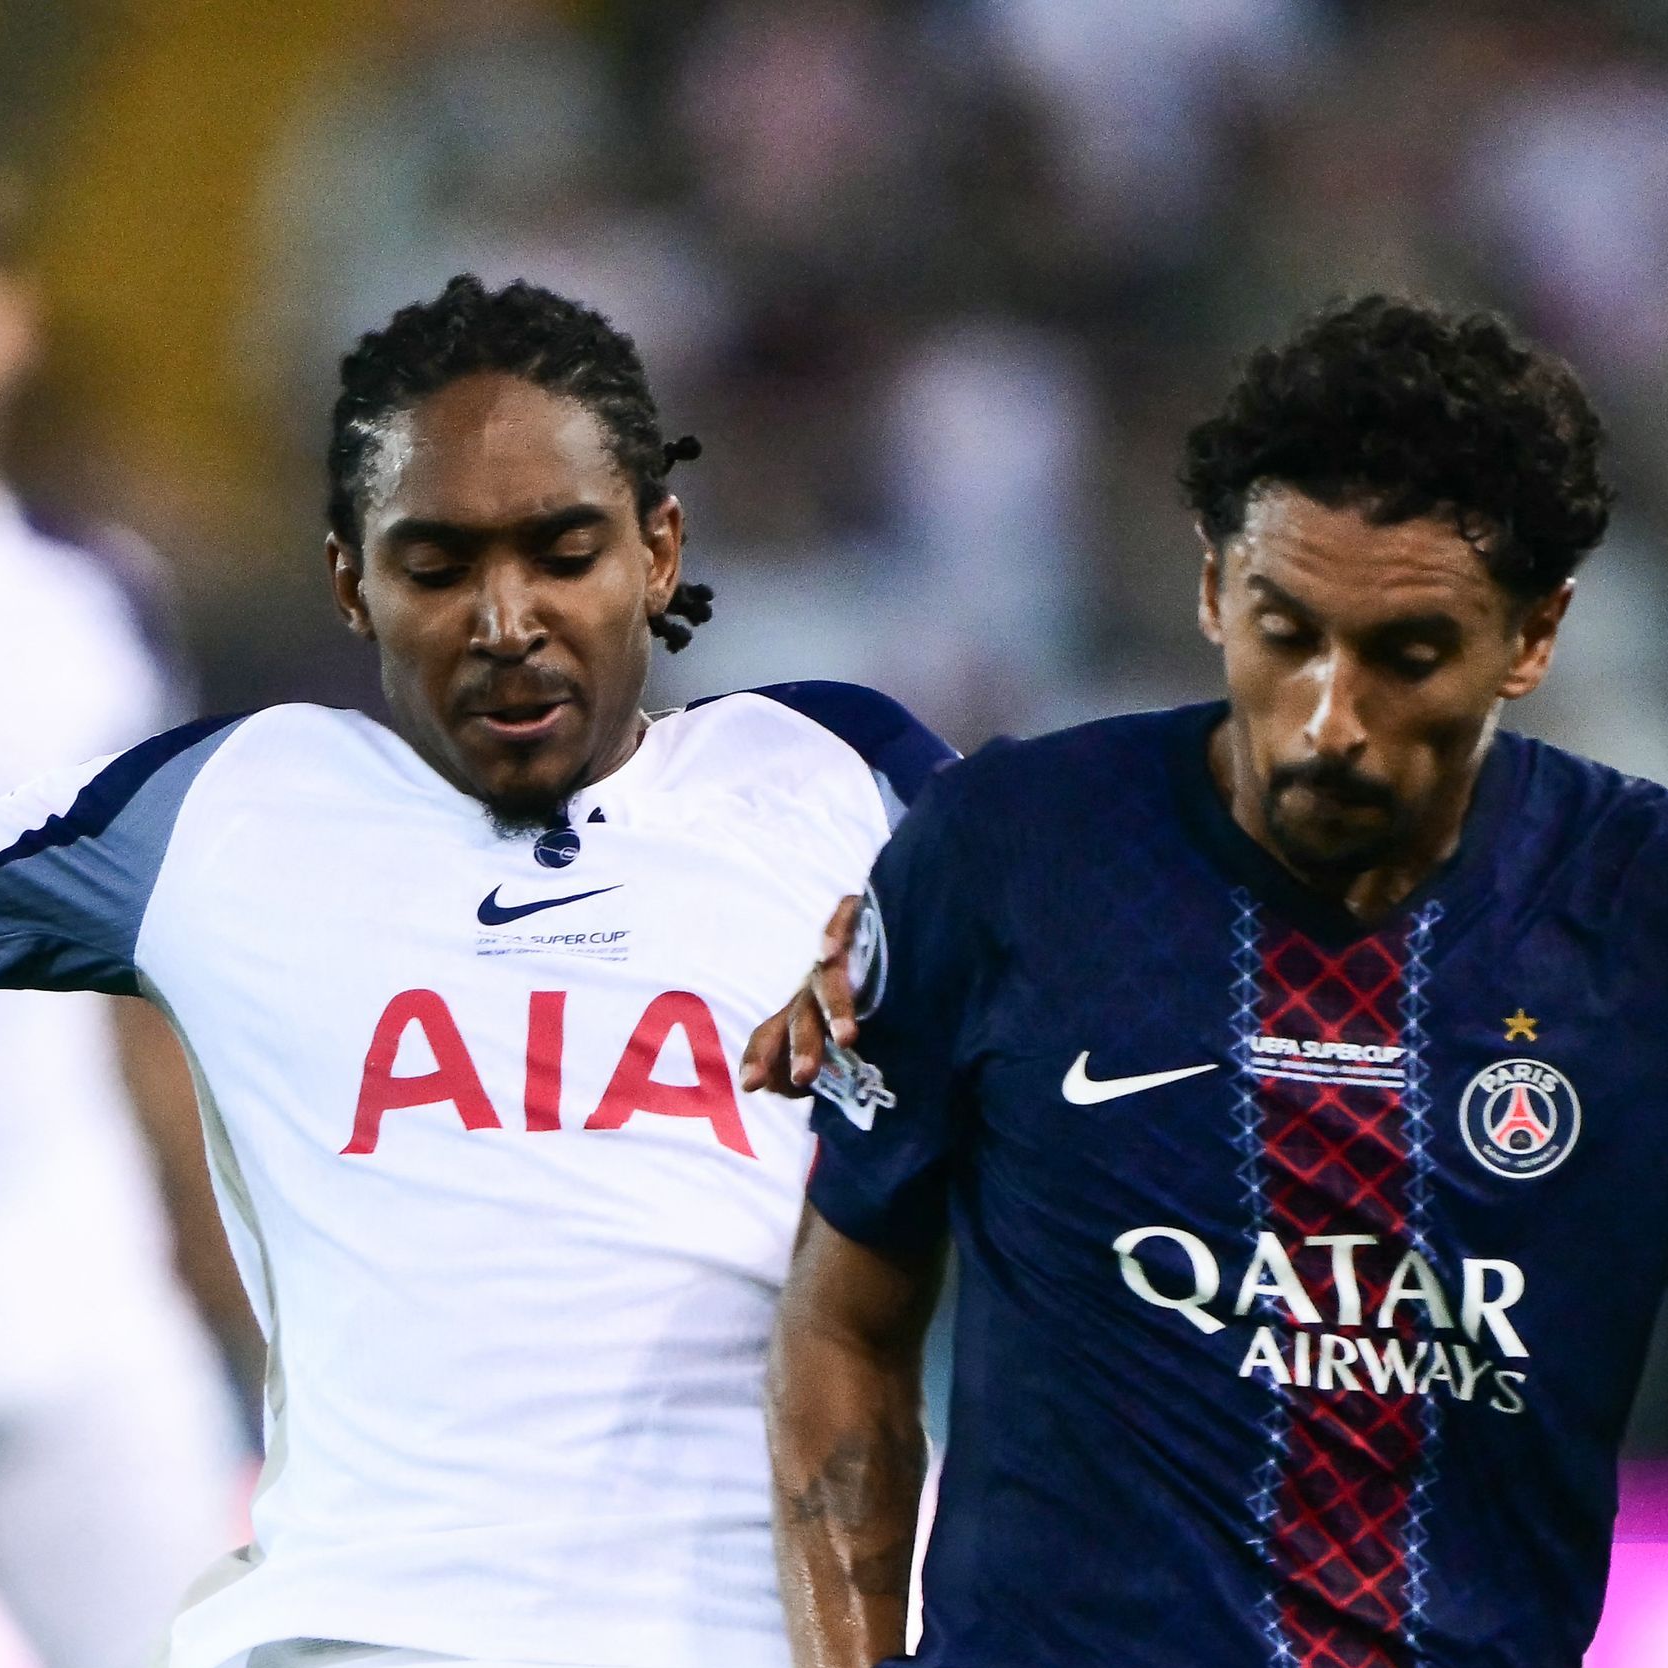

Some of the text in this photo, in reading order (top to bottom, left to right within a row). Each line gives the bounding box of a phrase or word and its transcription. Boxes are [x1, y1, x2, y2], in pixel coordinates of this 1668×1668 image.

[531, 933, 586, 945] SUPER
[589, 930, 626, 944] CUP
[339, 988, 759, 1160] AIA
[1478, 1063, 1560, 1093] PARIS
[1113, 1225, 1530, 1358] QATAR
[1238, 1326, 1526, 1414] AIRWAYS
